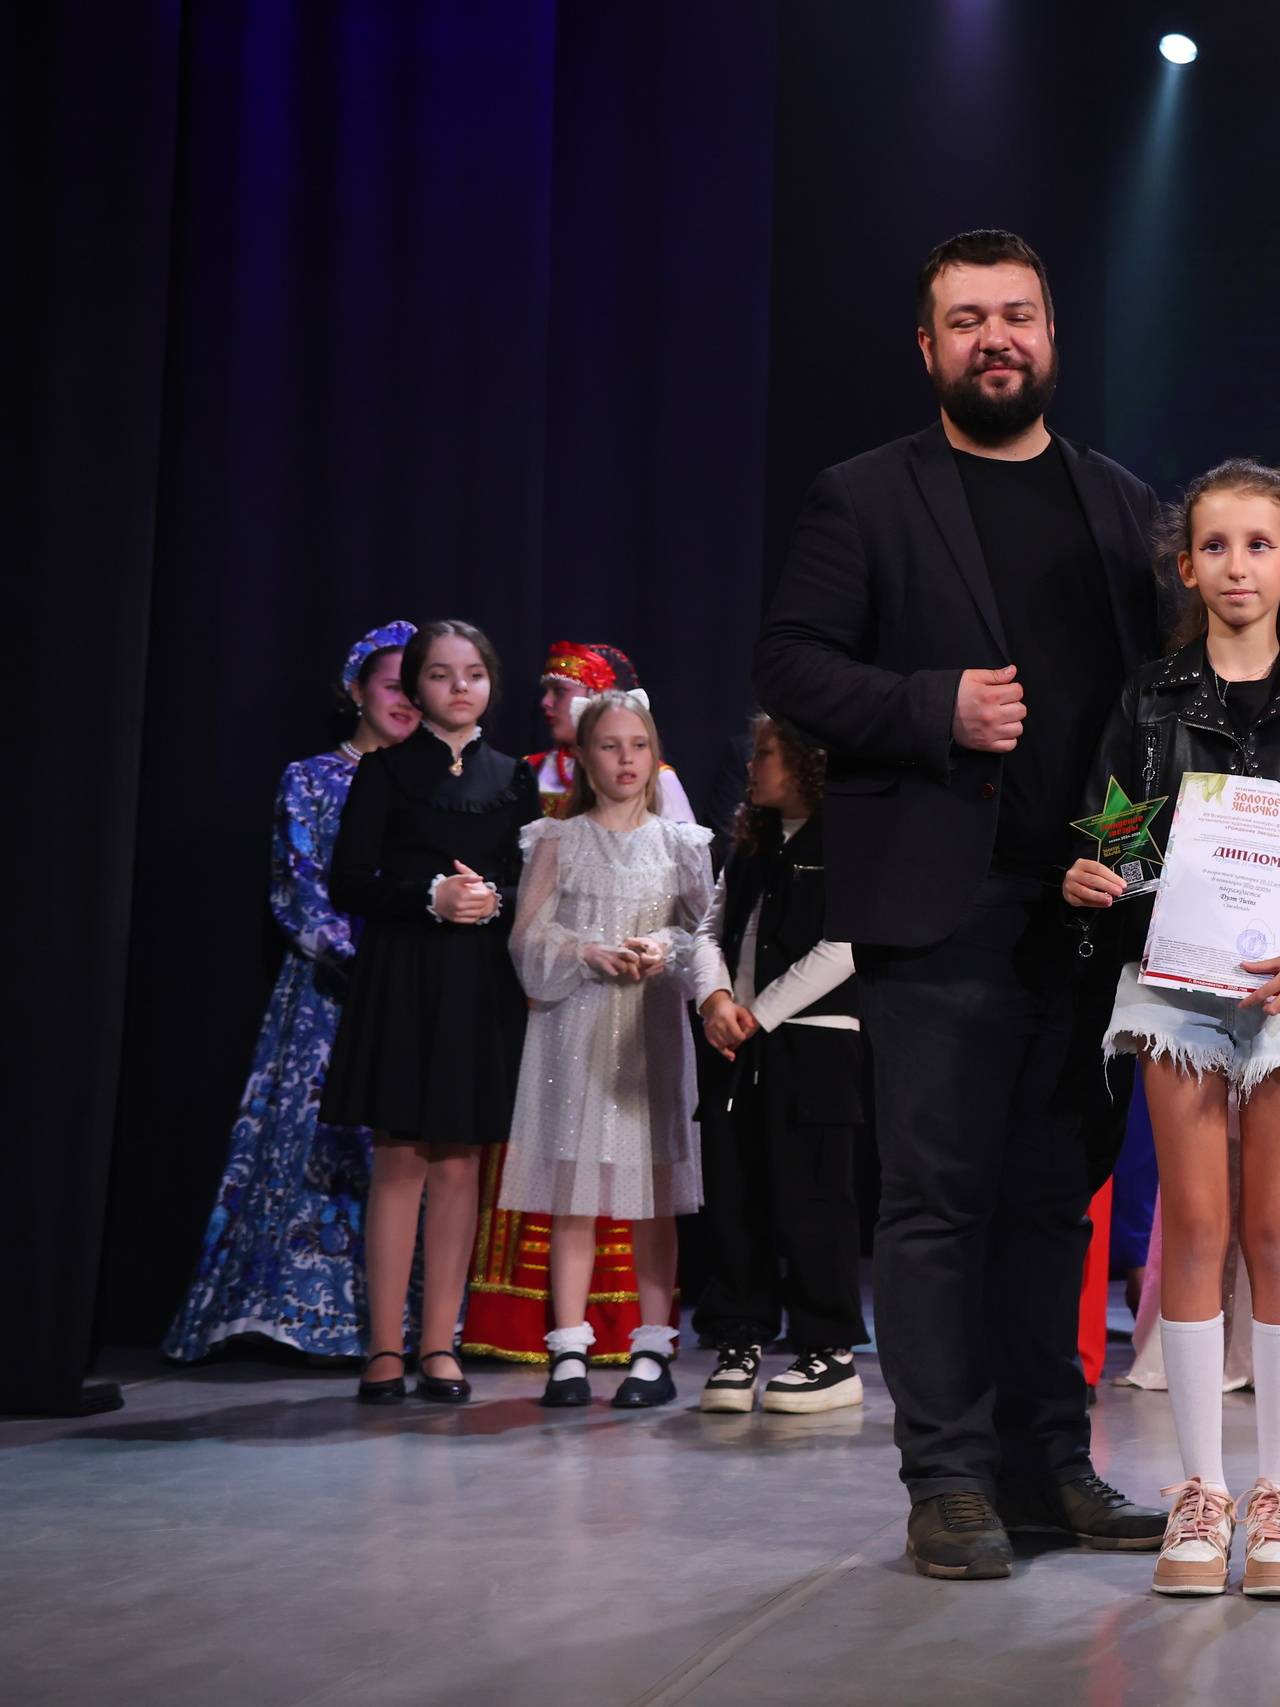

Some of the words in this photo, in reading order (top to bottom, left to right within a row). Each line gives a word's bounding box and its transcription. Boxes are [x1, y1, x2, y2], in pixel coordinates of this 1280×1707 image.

[1233, 791, 1280, 807] ЗОЛОТОЕ
[1231, 801, 1279, 817] ЯБЛОЧКО
[1220, 893, 1238, 902] Дуэт
